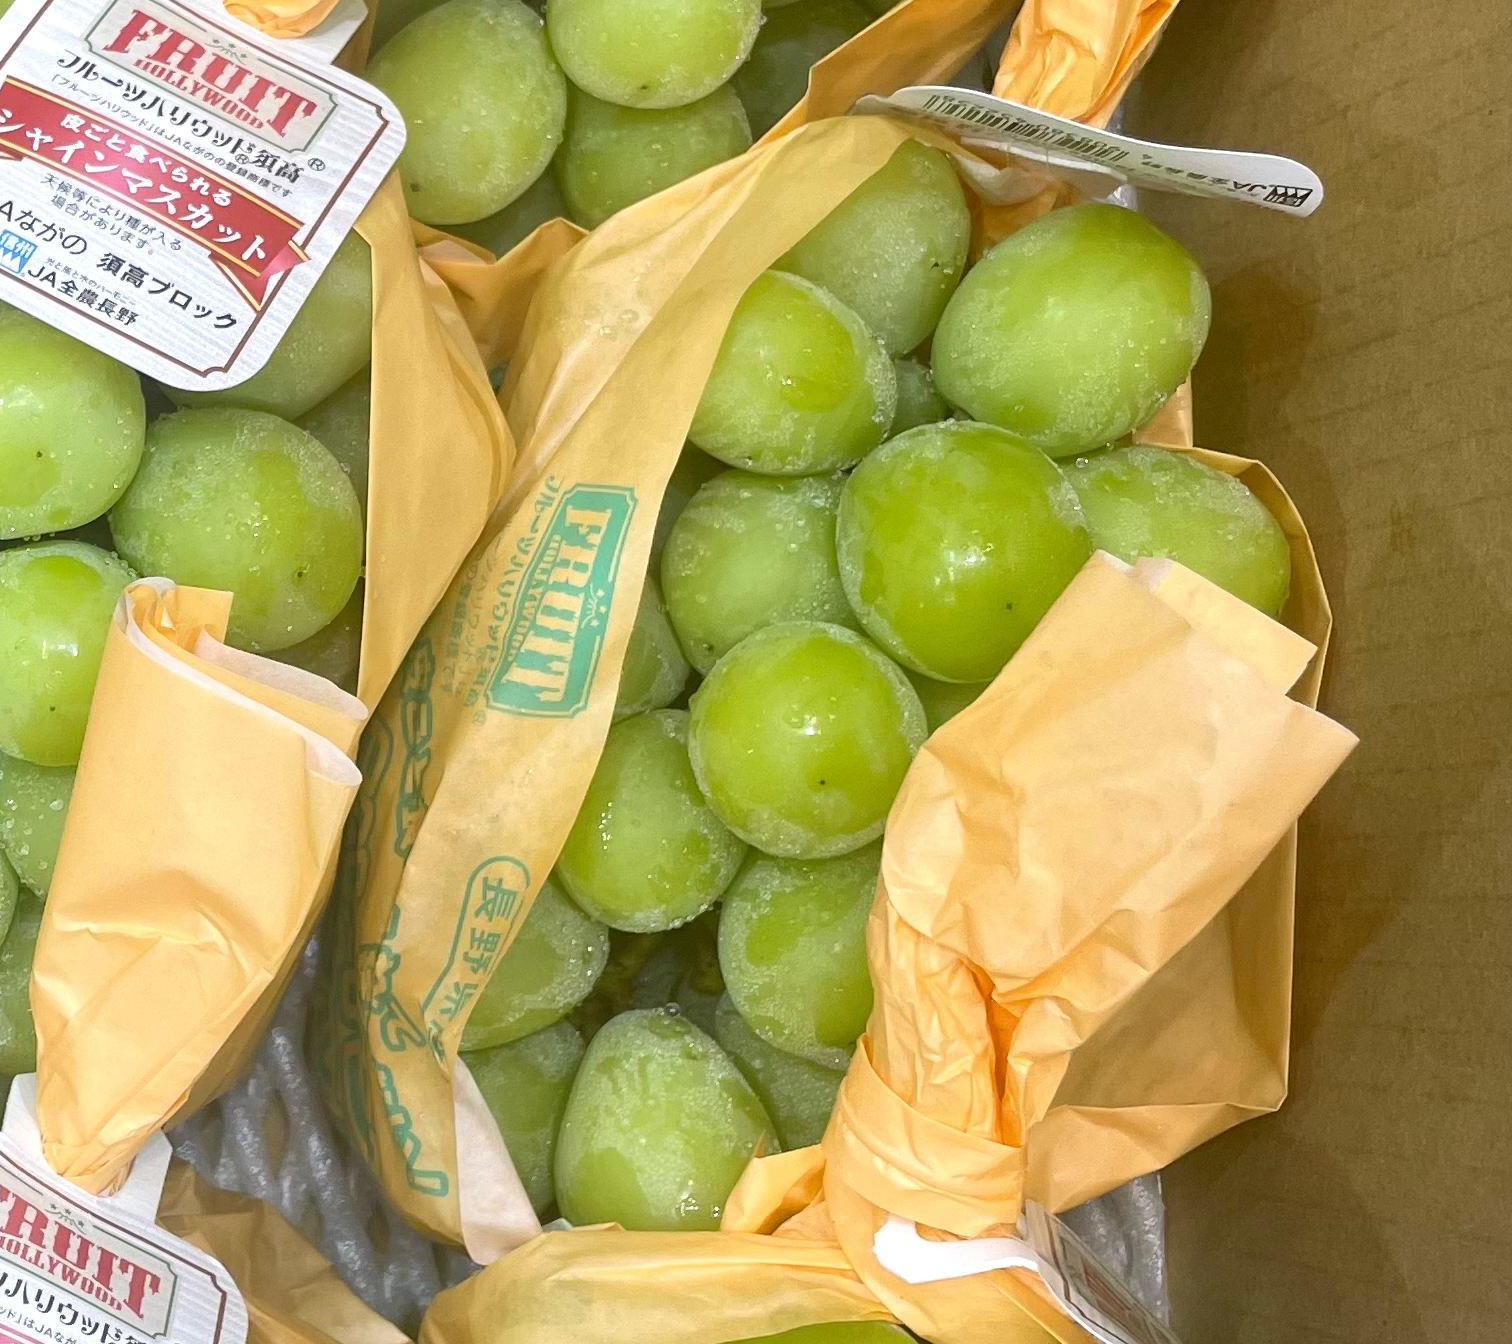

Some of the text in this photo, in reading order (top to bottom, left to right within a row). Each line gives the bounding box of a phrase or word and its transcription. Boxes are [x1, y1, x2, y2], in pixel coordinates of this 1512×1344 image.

[102, 9, 318, 138] FRUIT
[133, 57, 265, 131] HOLLYWOOD
[60, 112, 232, 207] 皮ごと食べられる
[40, 173, 182, 251] 天候等により種が入る
[50, 194, 155, 256] 場合があります。
[28, 265, 139, 326] JA全農長野
[96, 252, 237, 329] 須高ブロック
[500, 505, 612, 702] FRUIT
